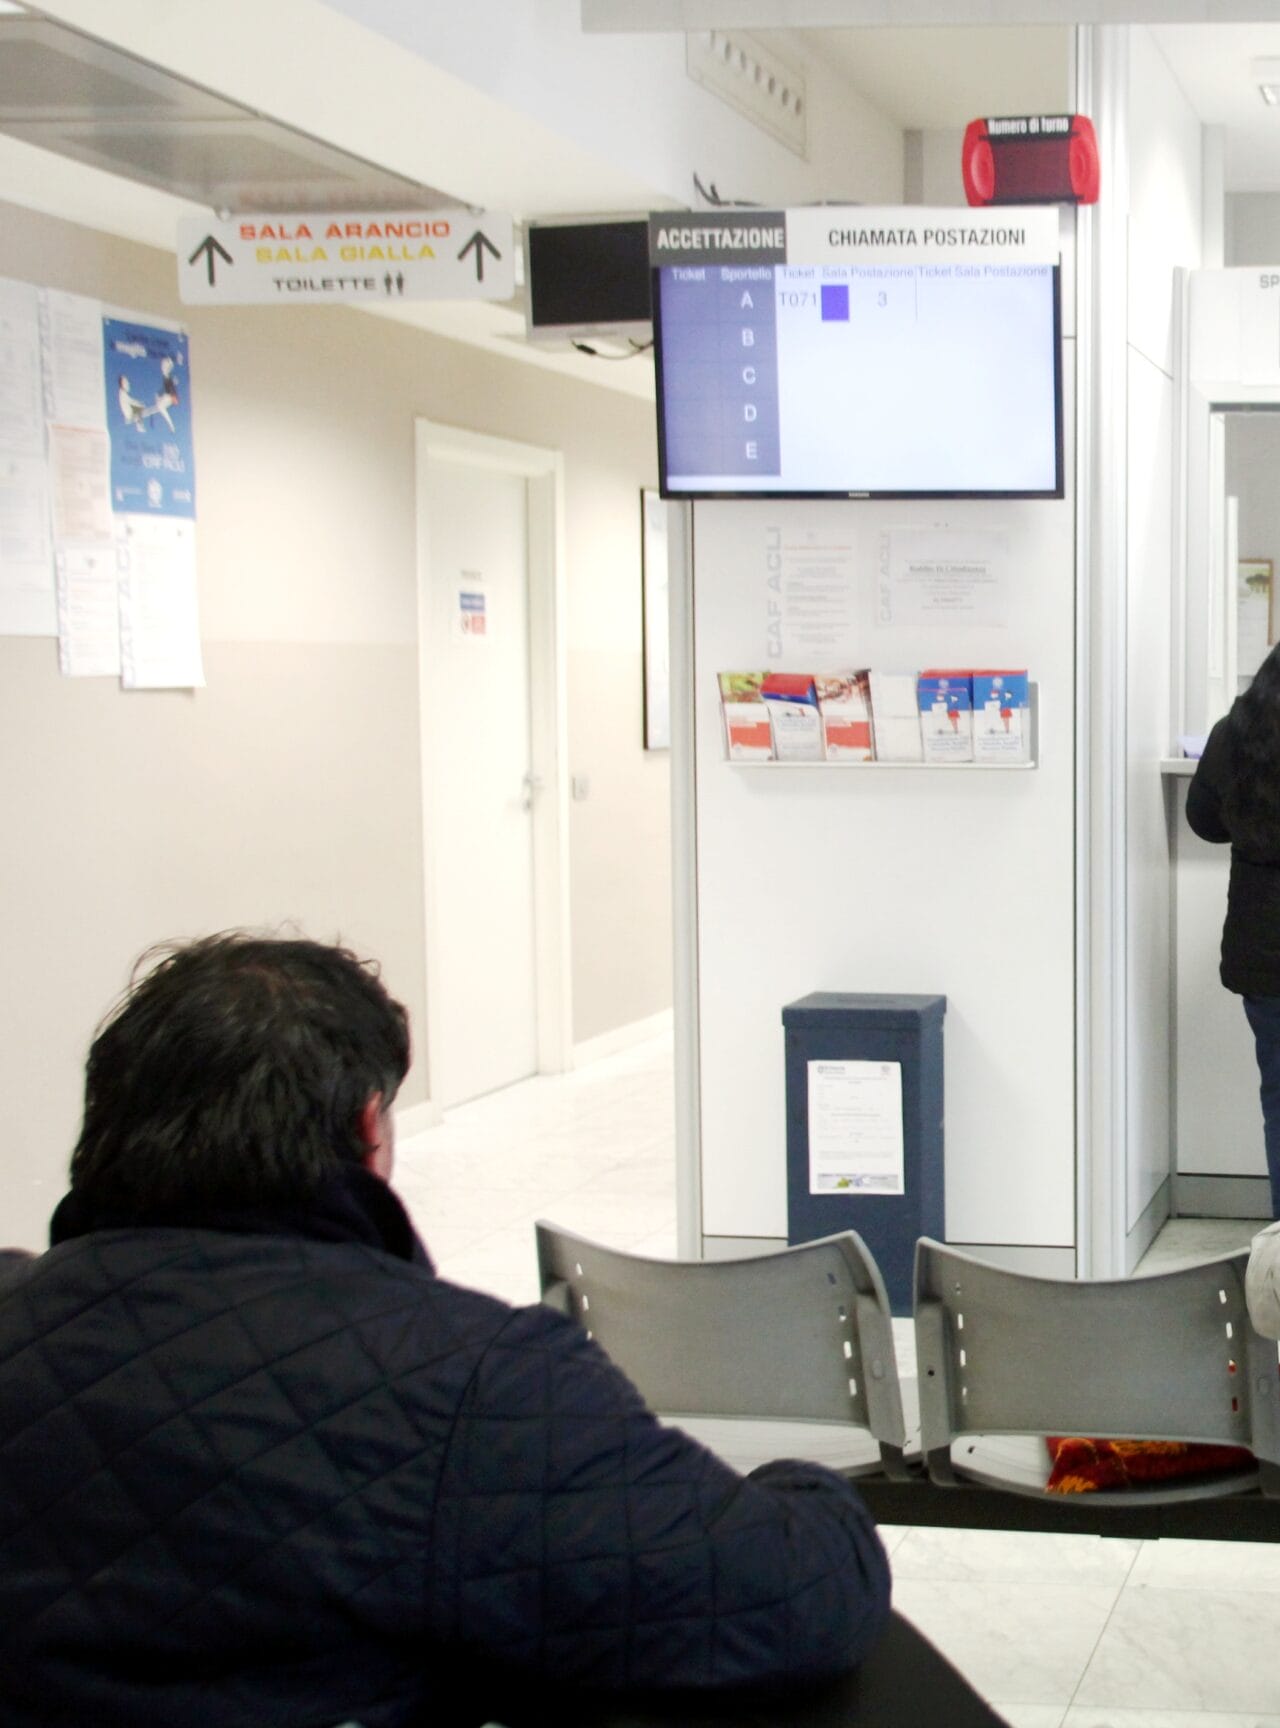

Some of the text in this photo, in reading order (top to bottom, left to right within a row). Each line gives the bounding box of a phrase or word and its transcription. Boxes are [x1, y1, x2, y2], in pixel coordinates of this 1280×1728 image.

[988, 118, 1027, 135] Numero
[1028, 117, 1040, 134] di
[239, 221, 451, 240] SALA ARANCIO
[656, 227, 784, 250] ACCETTAZIONE
[828, 228, 1025, 248] CHIAMATA POSTAZIONI
[254, 244, 436, 263] SALA GIALLA
[672, 267, 772, 282] Ticket Sportello
[273, 277, 376, 292] TOILETTE
[740, 290, 754, 309] A
[780, 291, 818, 307] T071
[877, 291, 889, 308] 3
[741, 327, 755, 347] B
[742, 366, 757, 385] C
[744, 404, 758, 422] D
[746, 441, 758, 460] E
